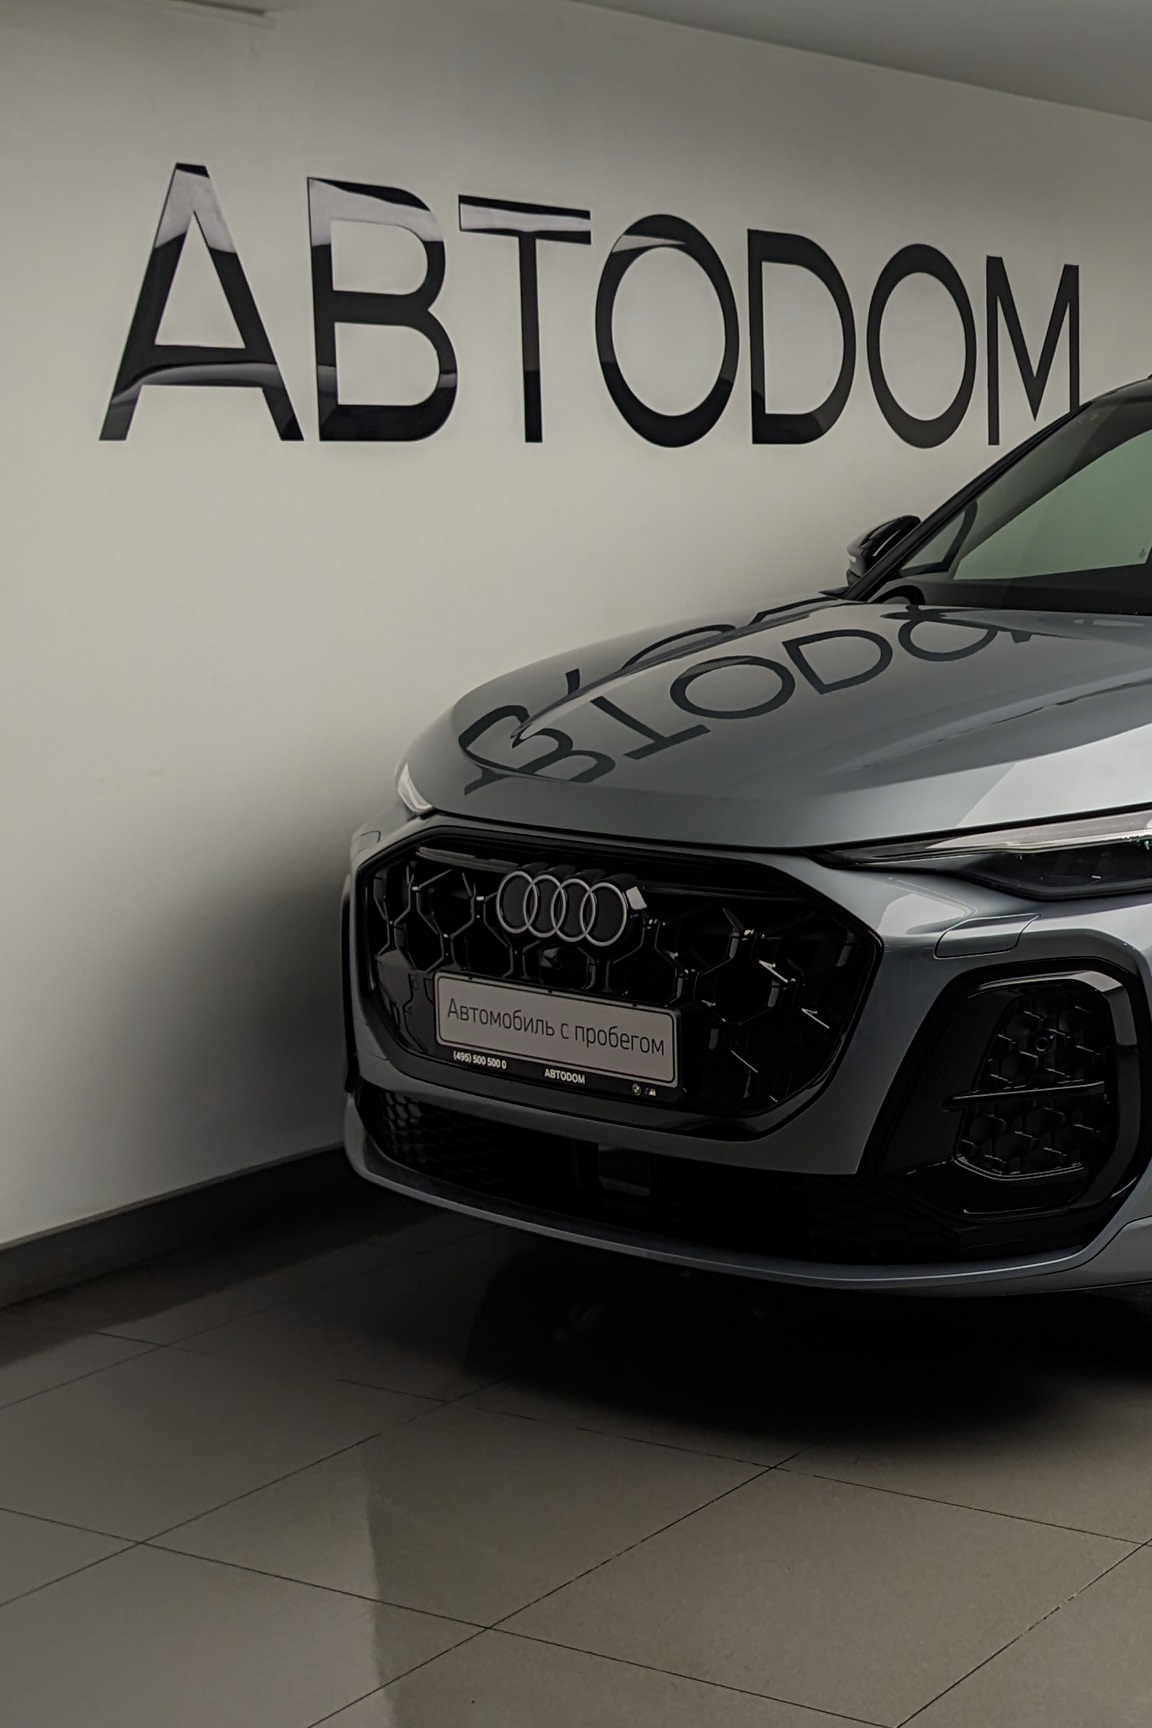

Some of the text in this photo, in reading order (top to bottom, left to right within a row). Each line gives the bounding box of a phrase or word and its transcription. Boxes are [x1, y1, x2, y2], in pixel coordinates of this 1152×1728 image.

[447, 998, 665, 1056] Автомобиль с пробегом
[453, 1050, 507, 1070] (495) 500 500 0
